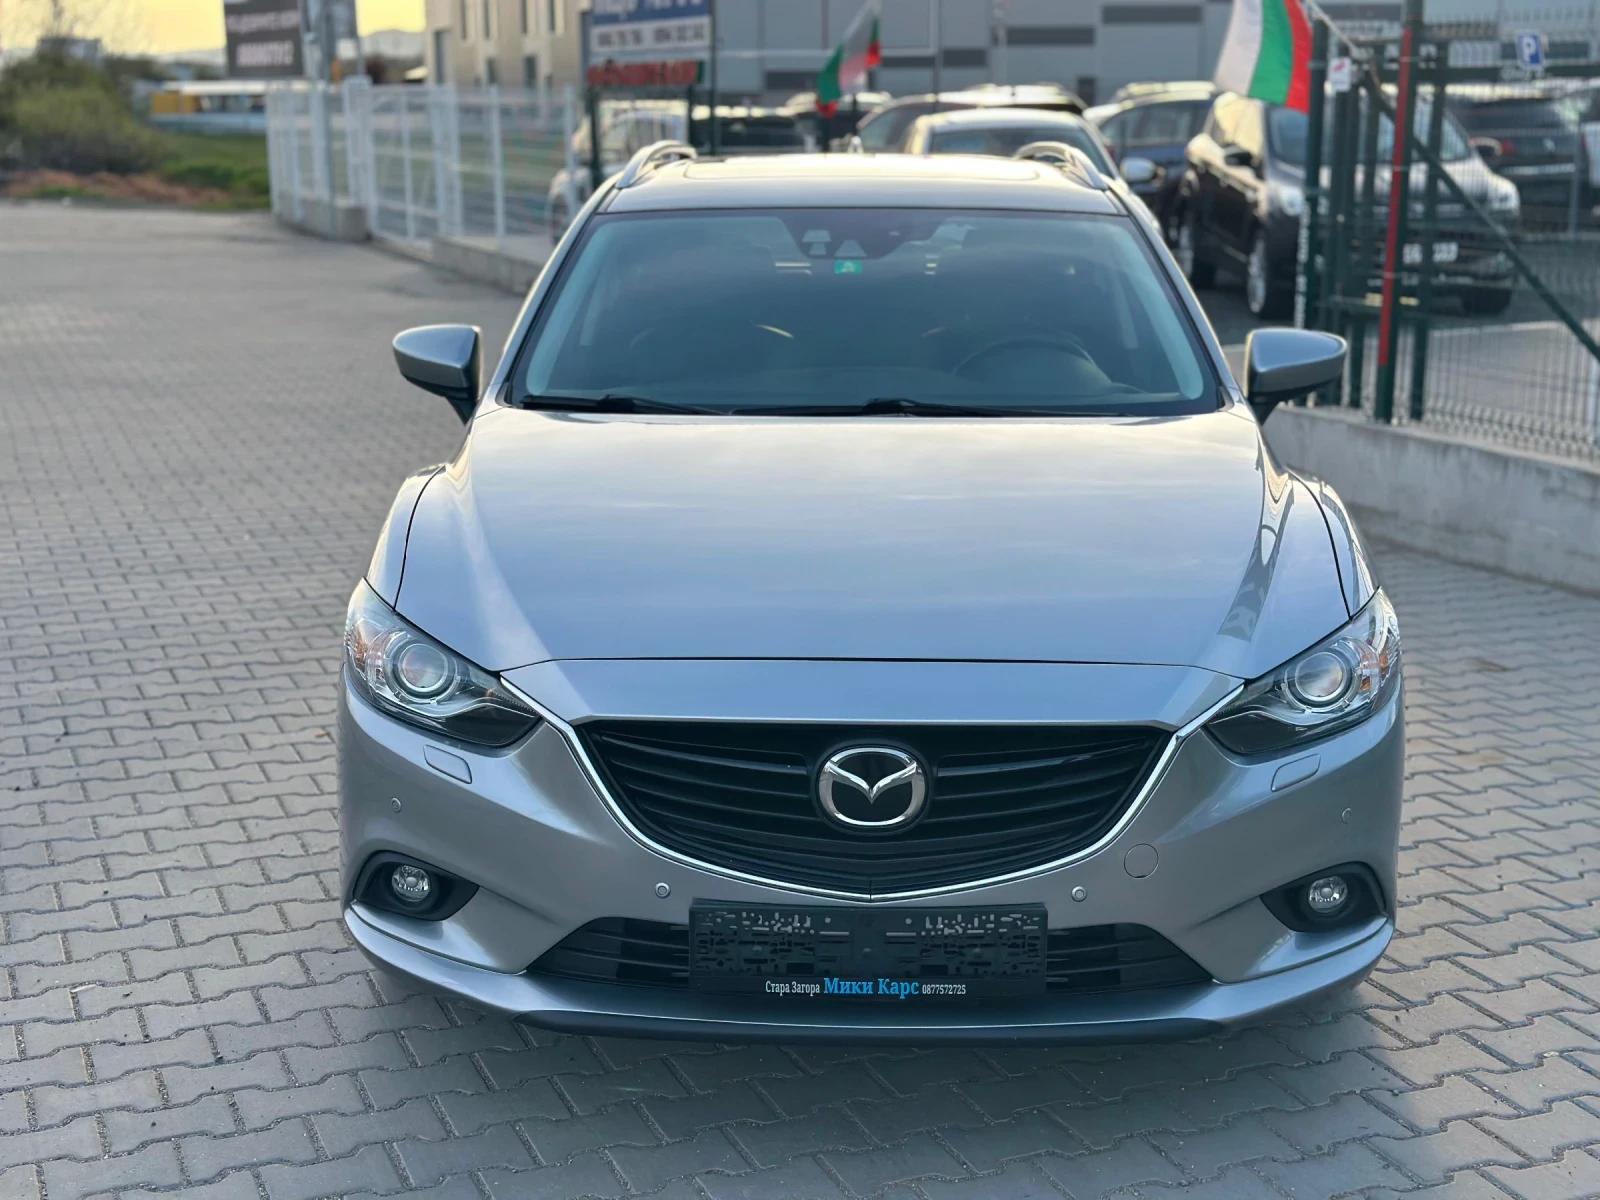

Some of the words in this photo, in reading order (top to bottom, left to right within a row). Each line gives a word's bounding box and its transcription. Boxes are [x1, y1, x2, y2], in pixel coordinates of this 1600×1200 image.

[765, 980, 790, 997] Стара
[791, 981, 820, 997] Загора
[823, 977, 873, 994] Мики
[877, 978, 919, 999] Карс
[922, 984, 966, 995] 0877572725
